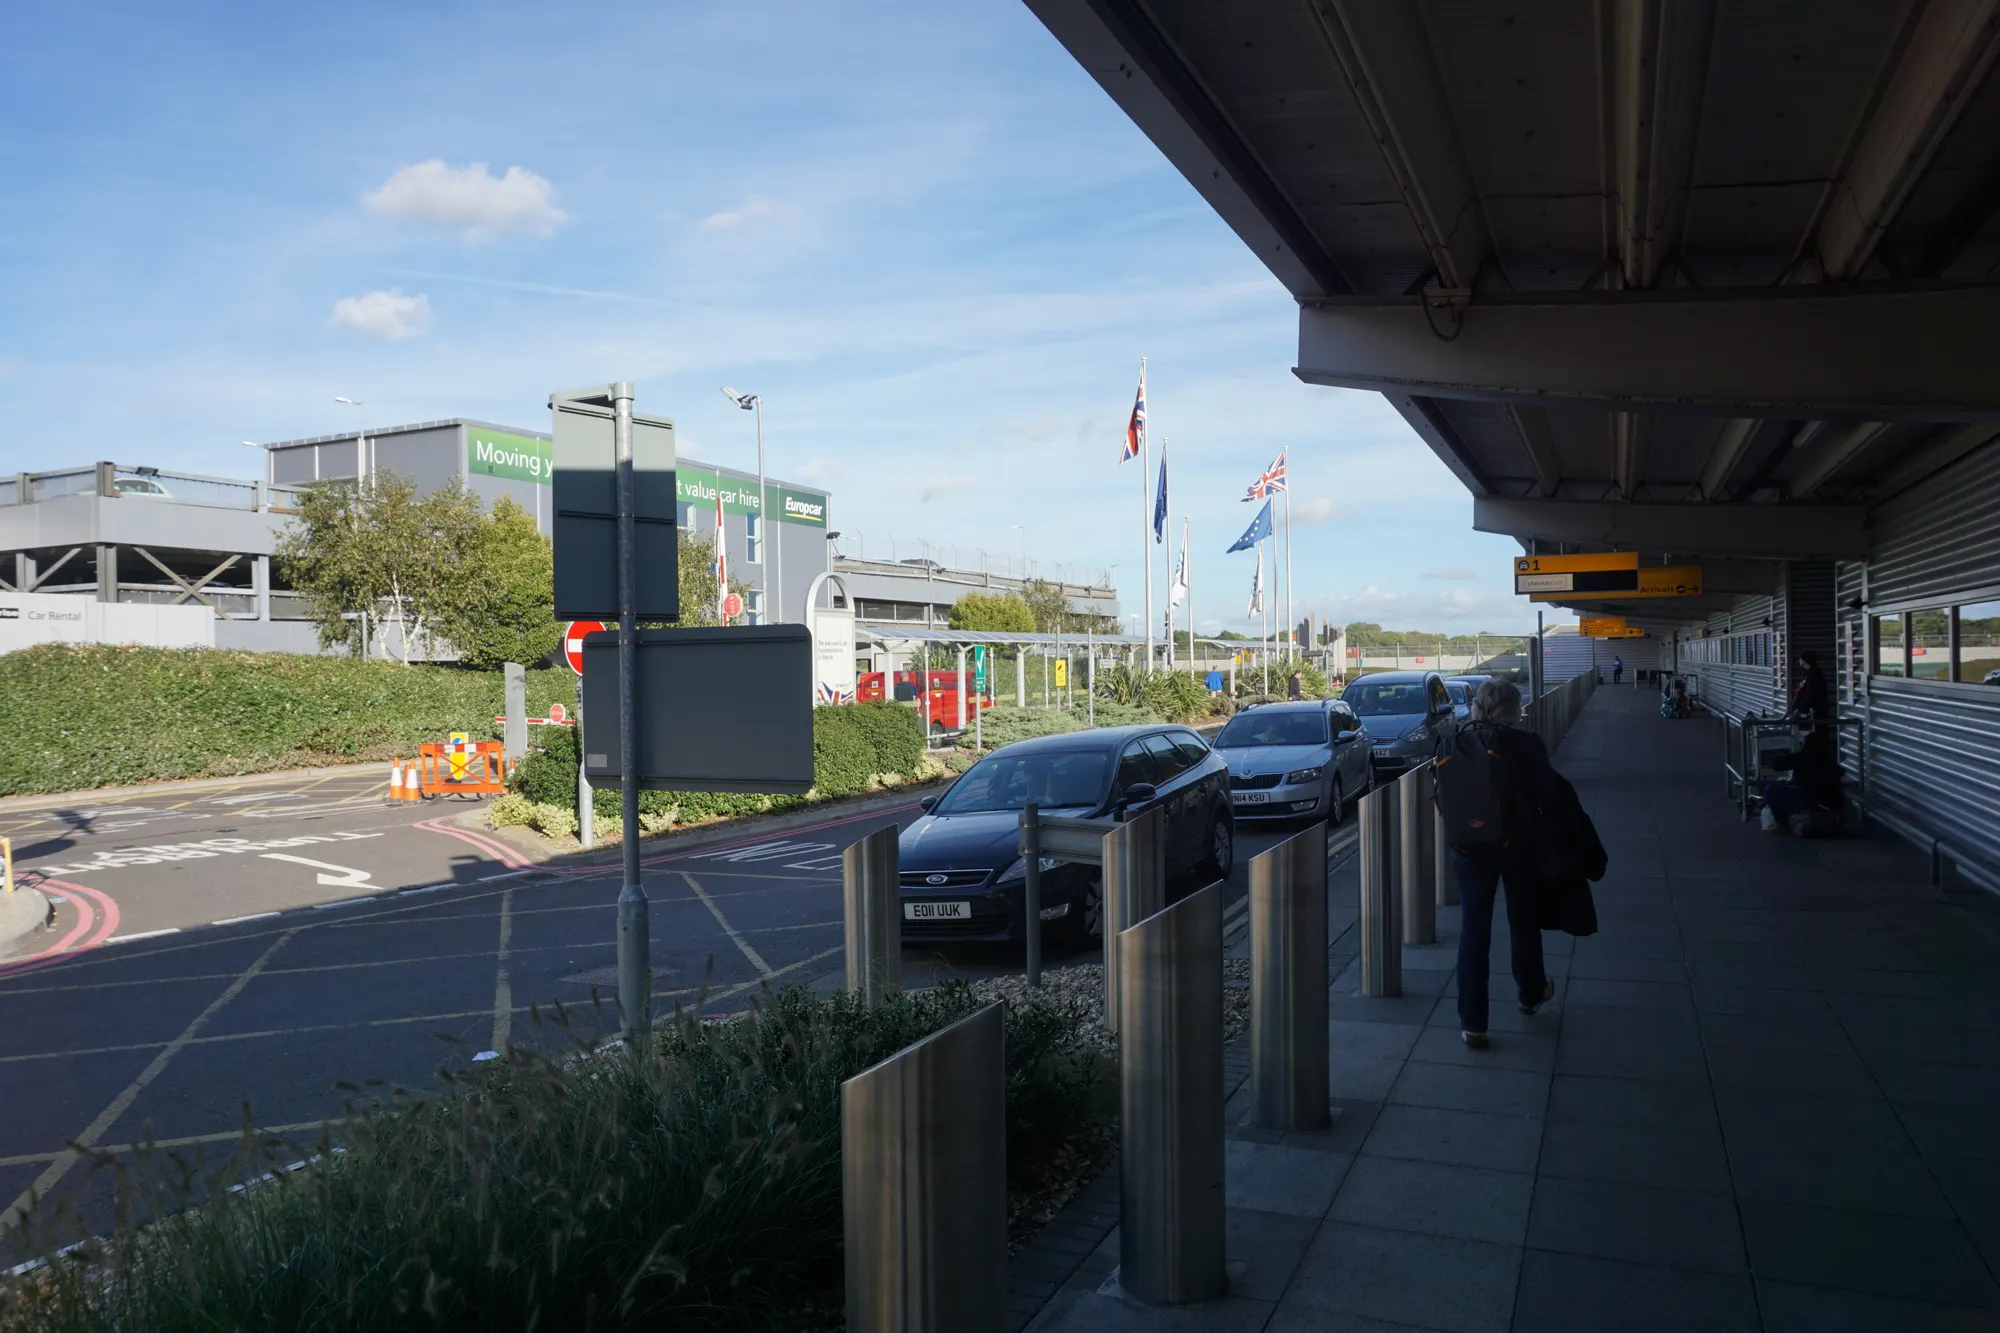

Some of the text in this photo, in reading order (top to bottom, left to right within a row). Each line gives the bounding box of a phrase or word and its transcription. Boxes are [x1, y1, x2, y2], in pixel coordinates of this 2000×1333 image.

[476, 440, 540, 476] Moving
[684, 480, 717, 501] value
[719, 489, 737, 504] car
[739, 488, 760, 508] hire
[785, 496, 823, 519] Europcar
[1532, 559, 1541, 571] 1
[1640, 584, 1674, 593] Arrivals
[27, 610, 46, 621] Car
[48, 610, 82, 621] Rental
[92, 837, 250, 861] ONLY
[213, 831, 385, 854] TURN
[937, 903, 961, 917] UUK
